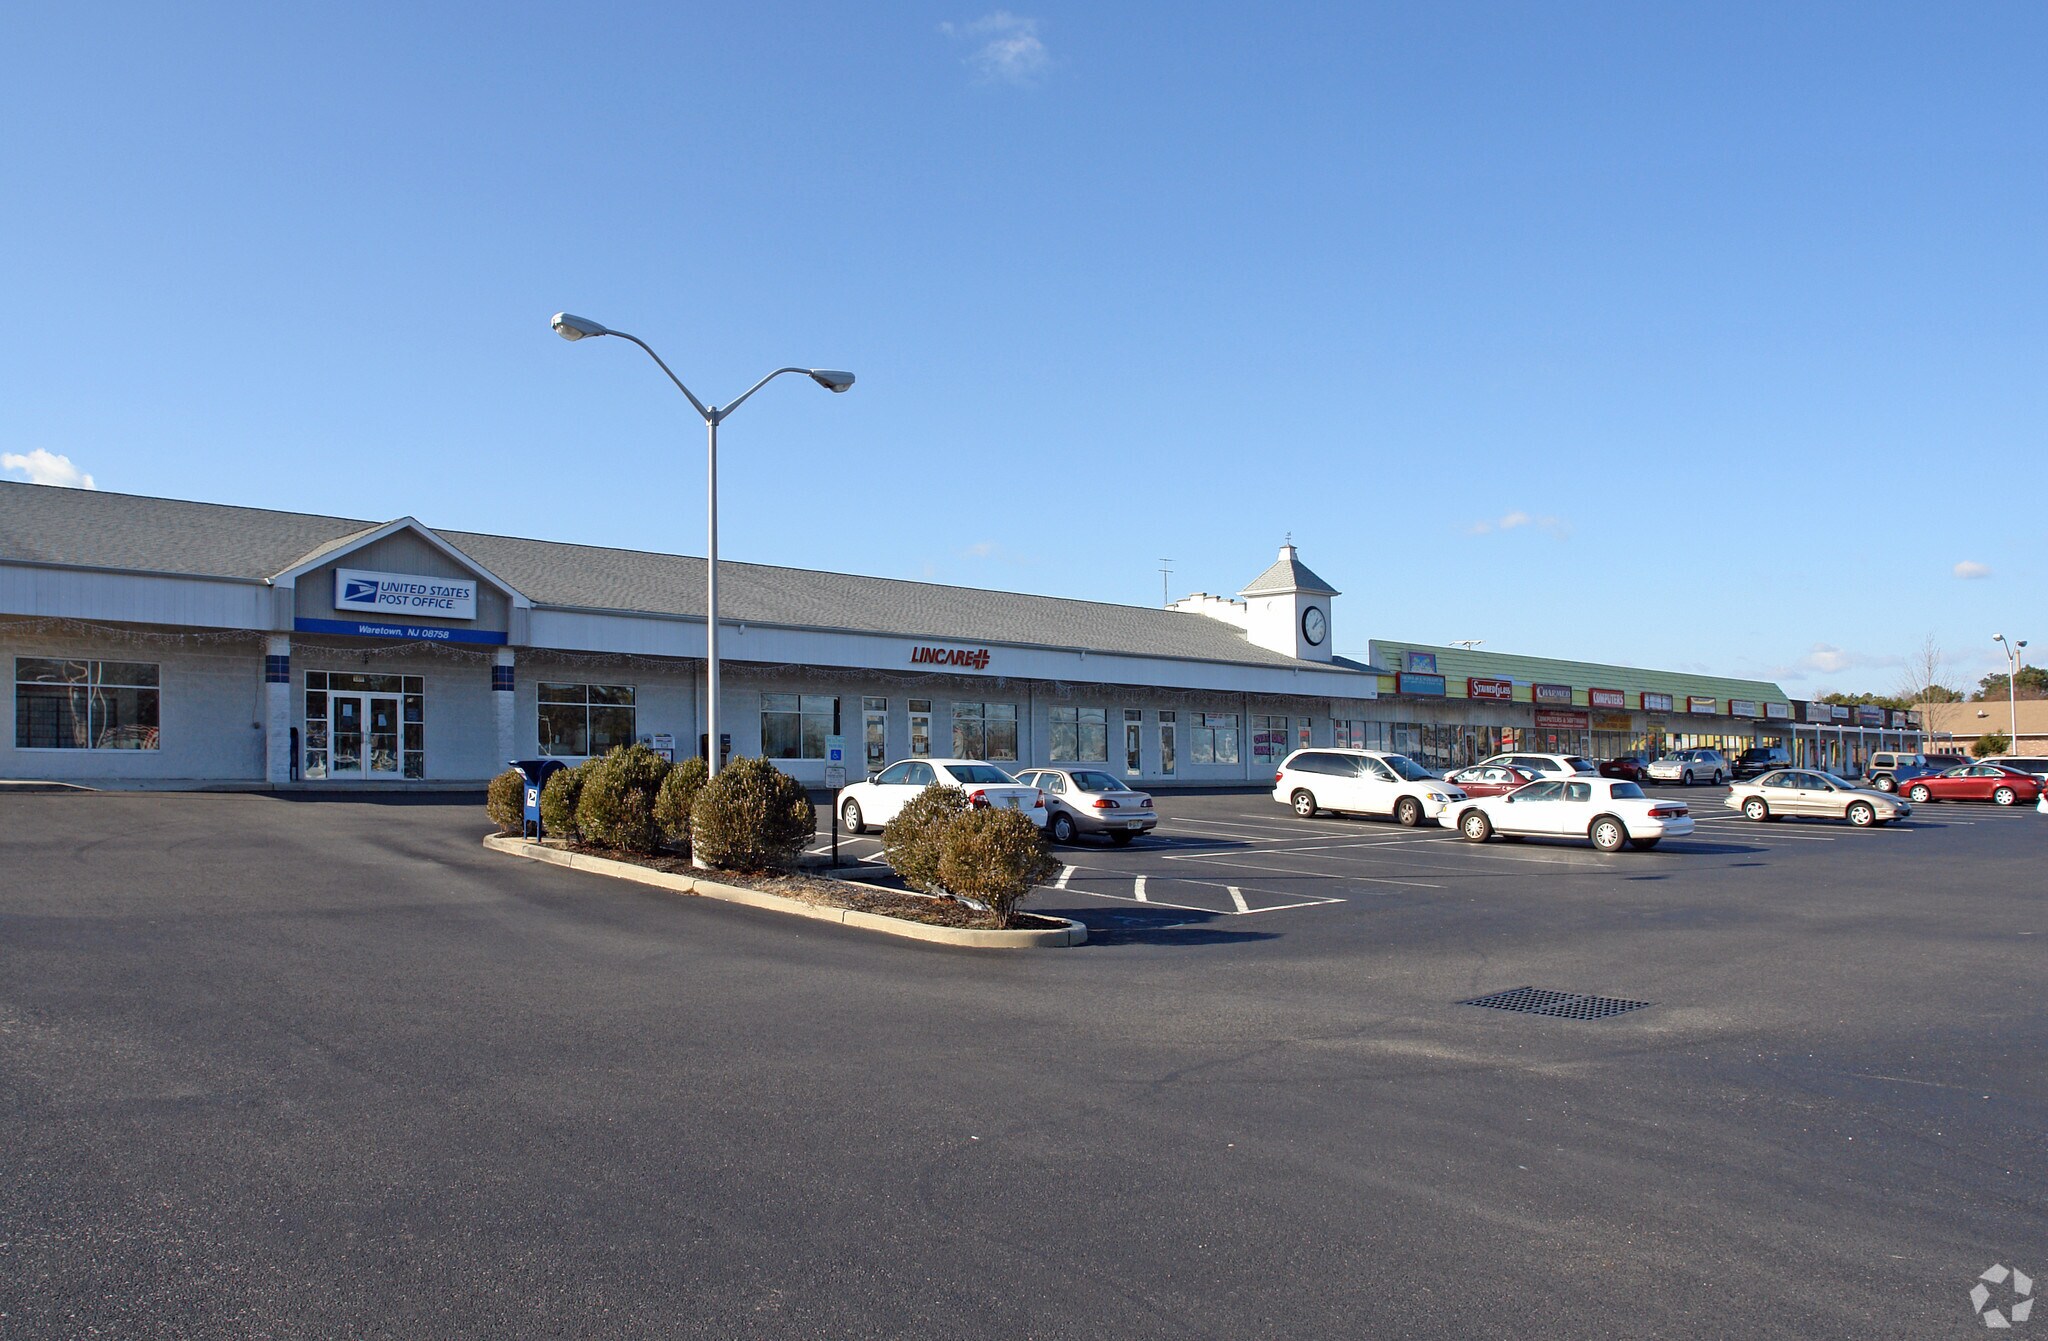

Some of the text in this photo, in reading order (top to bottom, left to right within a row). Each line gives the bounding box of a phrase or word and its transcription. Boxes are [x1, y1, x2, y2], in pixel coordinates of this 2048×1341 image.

[381, 582, 470, 598] UNITED STATES
[378, 596, 410, 605] POST
[358, 625, 450, 639] Waretown, NJ 08758
[911, 647, 974, 665] LINCARE
[1593, 691, 1624, 705] COMPUTERS
